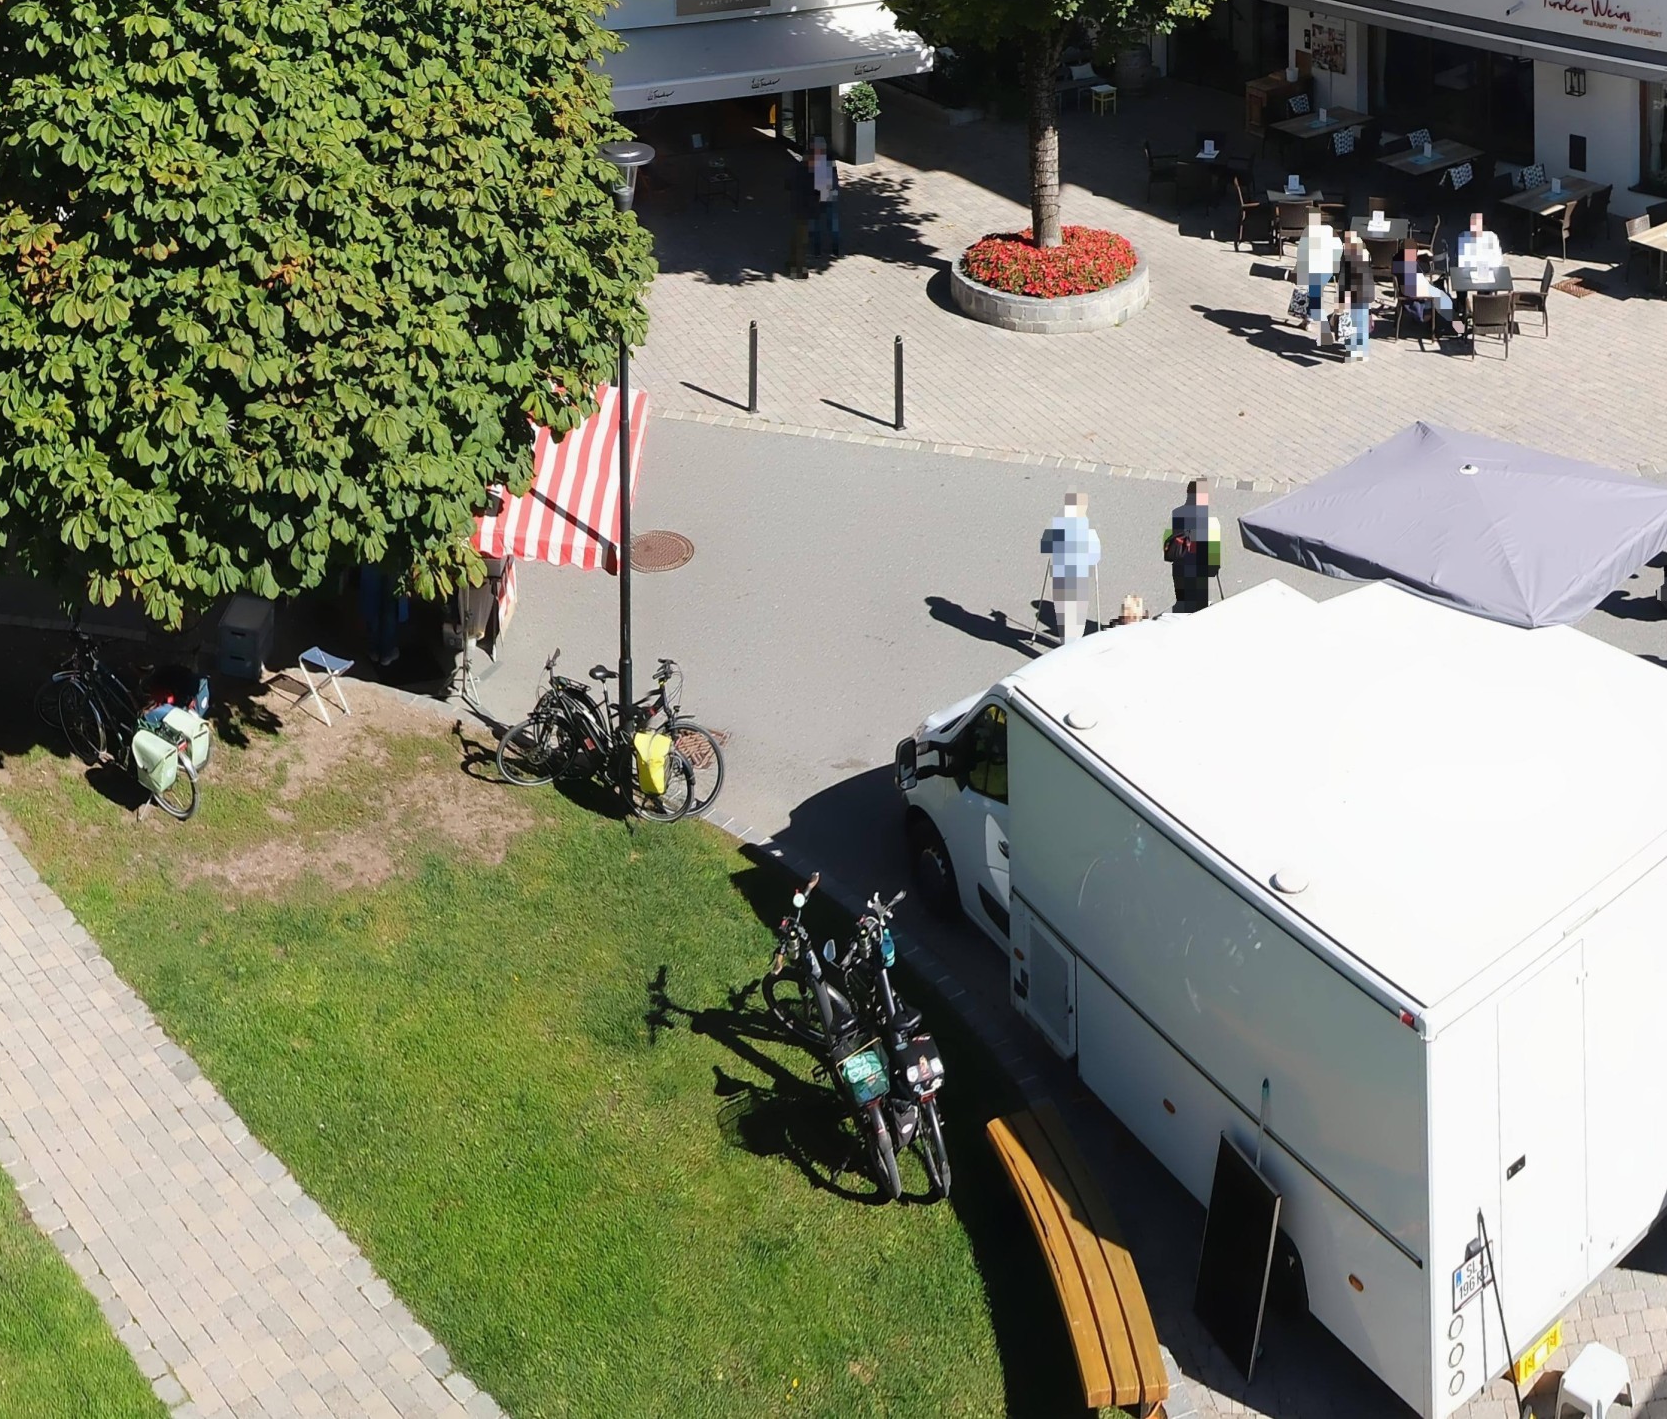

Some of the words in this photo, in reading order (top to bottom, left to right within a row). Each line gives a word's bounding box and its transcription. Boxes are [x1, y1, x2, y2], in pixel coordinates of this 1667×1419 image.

[1582, 19, 1618, 30] RESTAURANT
[1622, 26, 1663, 38] APPARTEMENT
[1466, 1261, 1478, 1279] SL
[1459, 1277, 1476, 1300] 196
